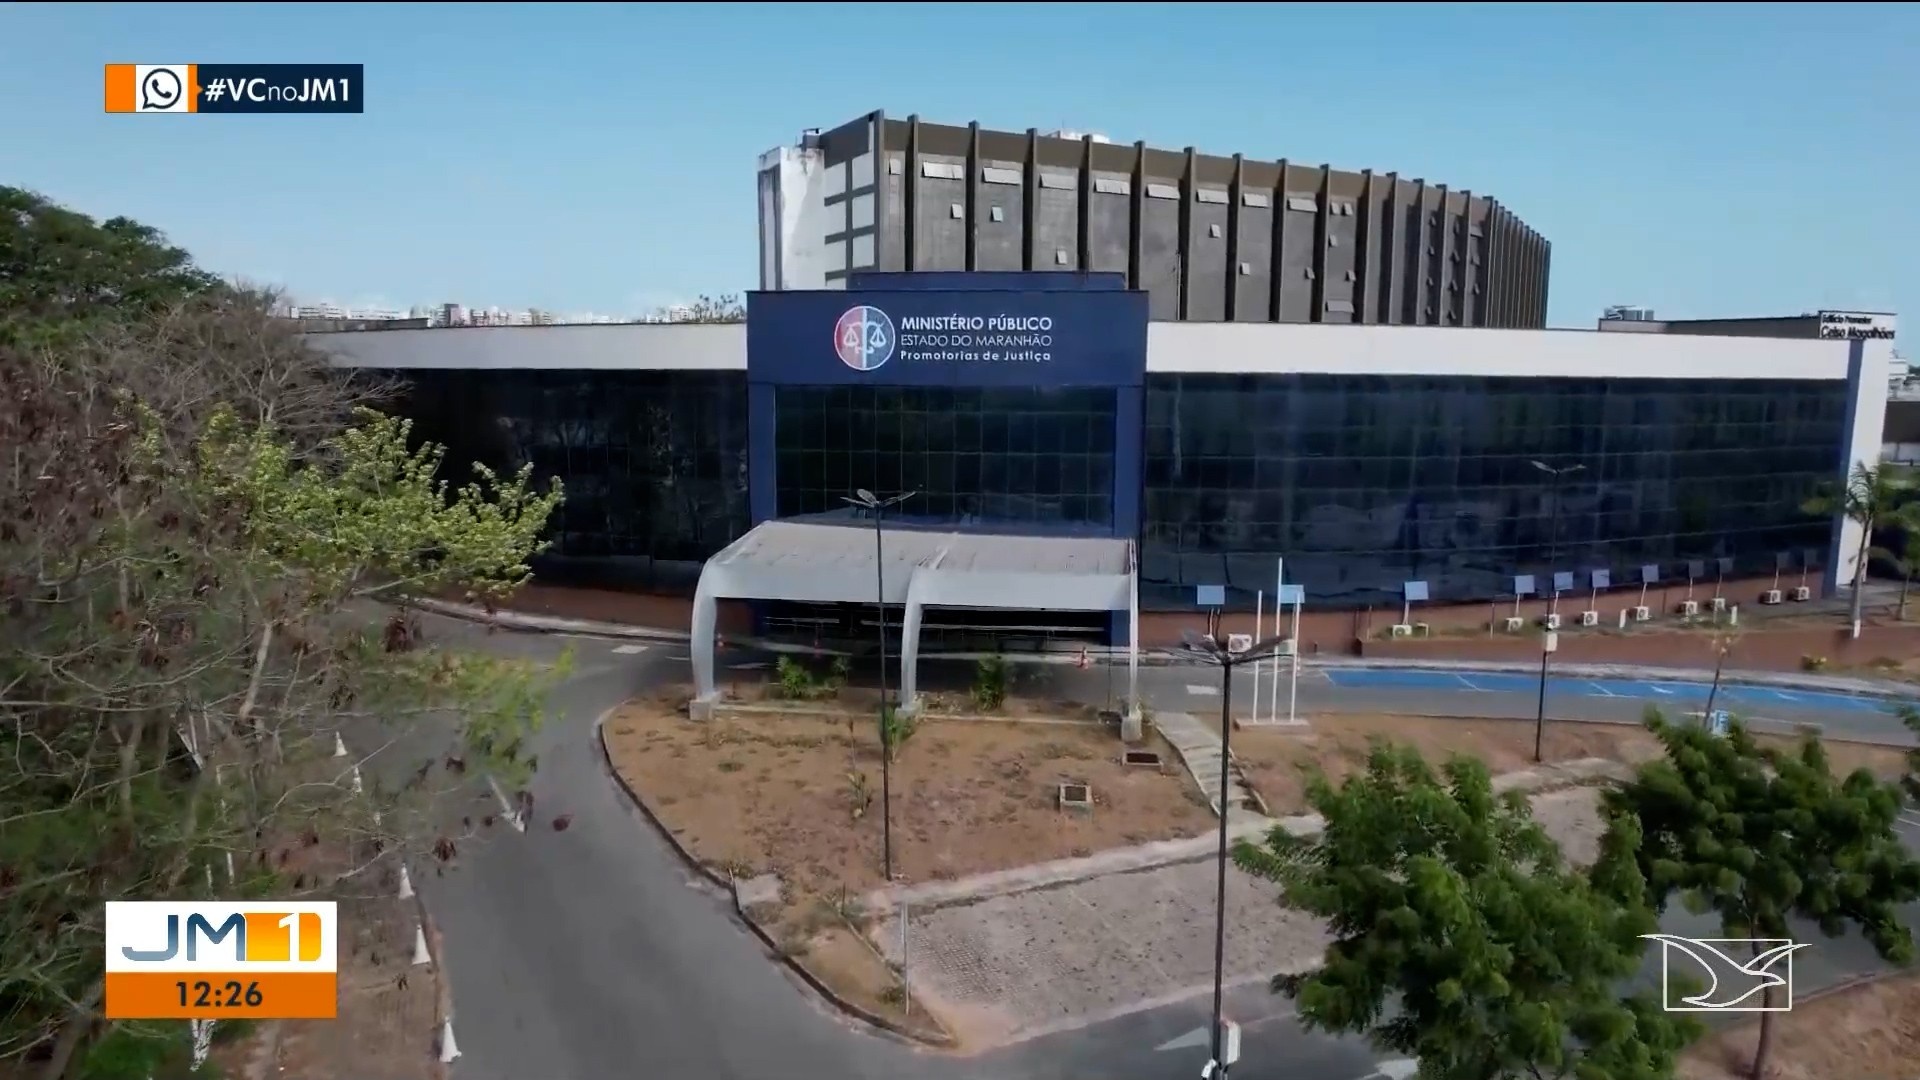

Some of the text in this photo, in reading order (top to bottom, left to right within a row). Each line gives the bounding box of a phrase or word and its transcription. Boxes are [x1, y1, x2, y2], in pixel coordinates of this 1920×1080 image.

[901, 313, 1053, 331] MINISTÉRIO PÚBLICO
[900, 332, 1052, 347] ESTADO DO MARANHÃO
[900, 350, 1051, 363] Promotorias de Justiça
